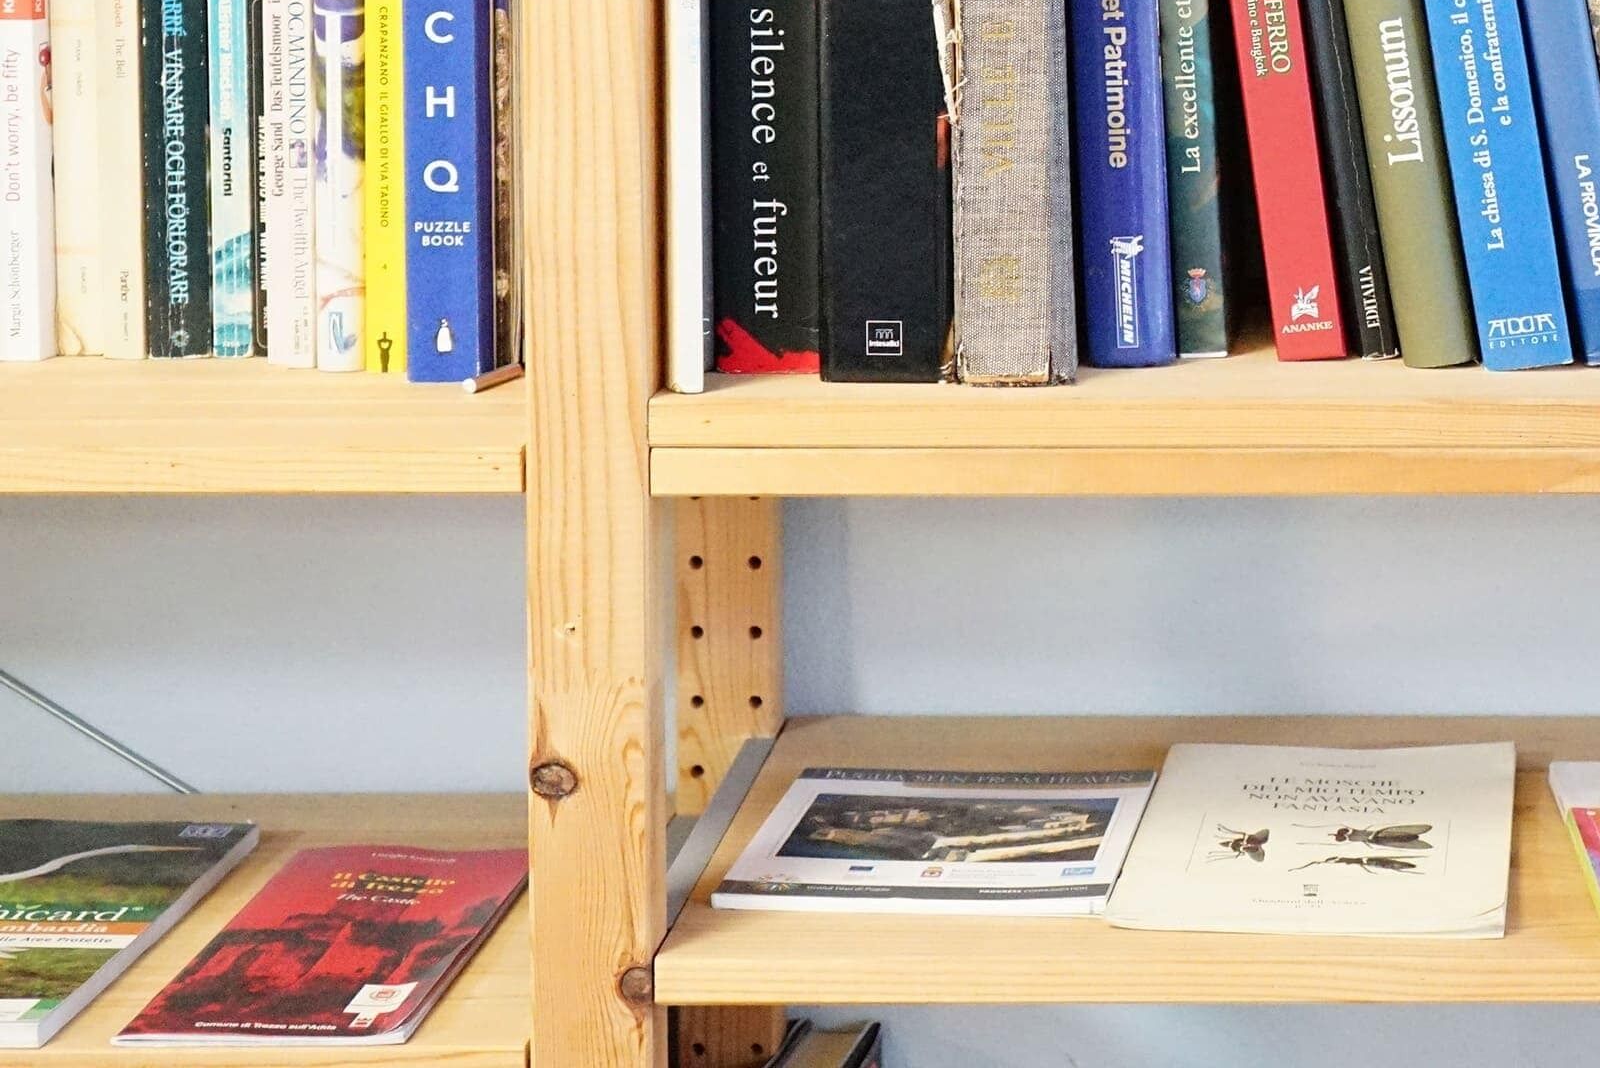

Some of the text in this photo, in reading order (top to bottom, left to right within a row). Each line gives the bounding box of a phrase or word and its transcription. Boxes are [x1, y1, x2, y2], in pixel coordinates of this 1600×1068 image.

[287, 0, 306, 31] OG
[1249, 19, 1258, 27] e
[1450, 12, 1469, 25] il
[980, 20, 1015, 42] E
[114, 37, 126, 56] The
[269, 14, 283, 90] Teufelsmoor
[1249, 29, 1268, 77] Bangkok
[1, 48, 21, 79] fifty
[114, 59, 127, 79] Bell
[1457, 28, 1486, 125] Domenico,
[3, 84, 19, 103] be
[162, 47, 187, 137] VINNARE
[287, 34, 306, 134] MANDINO
[1103, 27, 1131, 169] Patrimoine
[1175, 26, 1199, 140] excellente
[1378, 16, 1424, 167] Lissonum
[269, 90, 283, 113] Das
[1491, 96, 1510, 113] la
[378, 5, 389, 229] CRAPANZANO IL GIALLO DI VIA TADINO
[980, 62, 1016, 179] VILLE
[1499, 115, 1512, 126] e
[270, 122, 284, 152] Sand
[1470, 130, 1488, 146] S.
[164, 138, 187, 189] OCH
[221, 126, 234, 197] Santorini
[750, 7, 787, 319] silence et fureur
[1180, 146, 1202, 173] La
[1473, 150, 1492, 168] di
[1573, 154, 1591, 179] LA
[4, 161, 21, 204] Don't
[271, 154, 286, 199] George
[292, 174, 309, 204] The
[1480, 172, 1502, 224] chiesa
[292, 205, 310, 256] Twelfth
[414, 221, 472, 234] PUZZLE
[422, 234, 464, 247] BOOK
[1486, 227, 1505, 251] La
[166, 190, 191, 305] FÖRLORARE
[291, 256, 310, 301] Angel
[1119, 258, 1136, 344] MICHELIN
[1358, 265, 1381, 330] EDITALIA
[1281, 320, 1333, 334] ANANKE
[1489, 334, 1558, 349] EDITORE
[1294, 786, 1340, 794] MIO
[1346, 788, 1426, 797] TEMPO
[1304, 777, 1402, 788] MOSCHE
[1248, 792, 1417, 806] NON AVEVANO
[1272, 801, 1387, 815] FANTASIA
